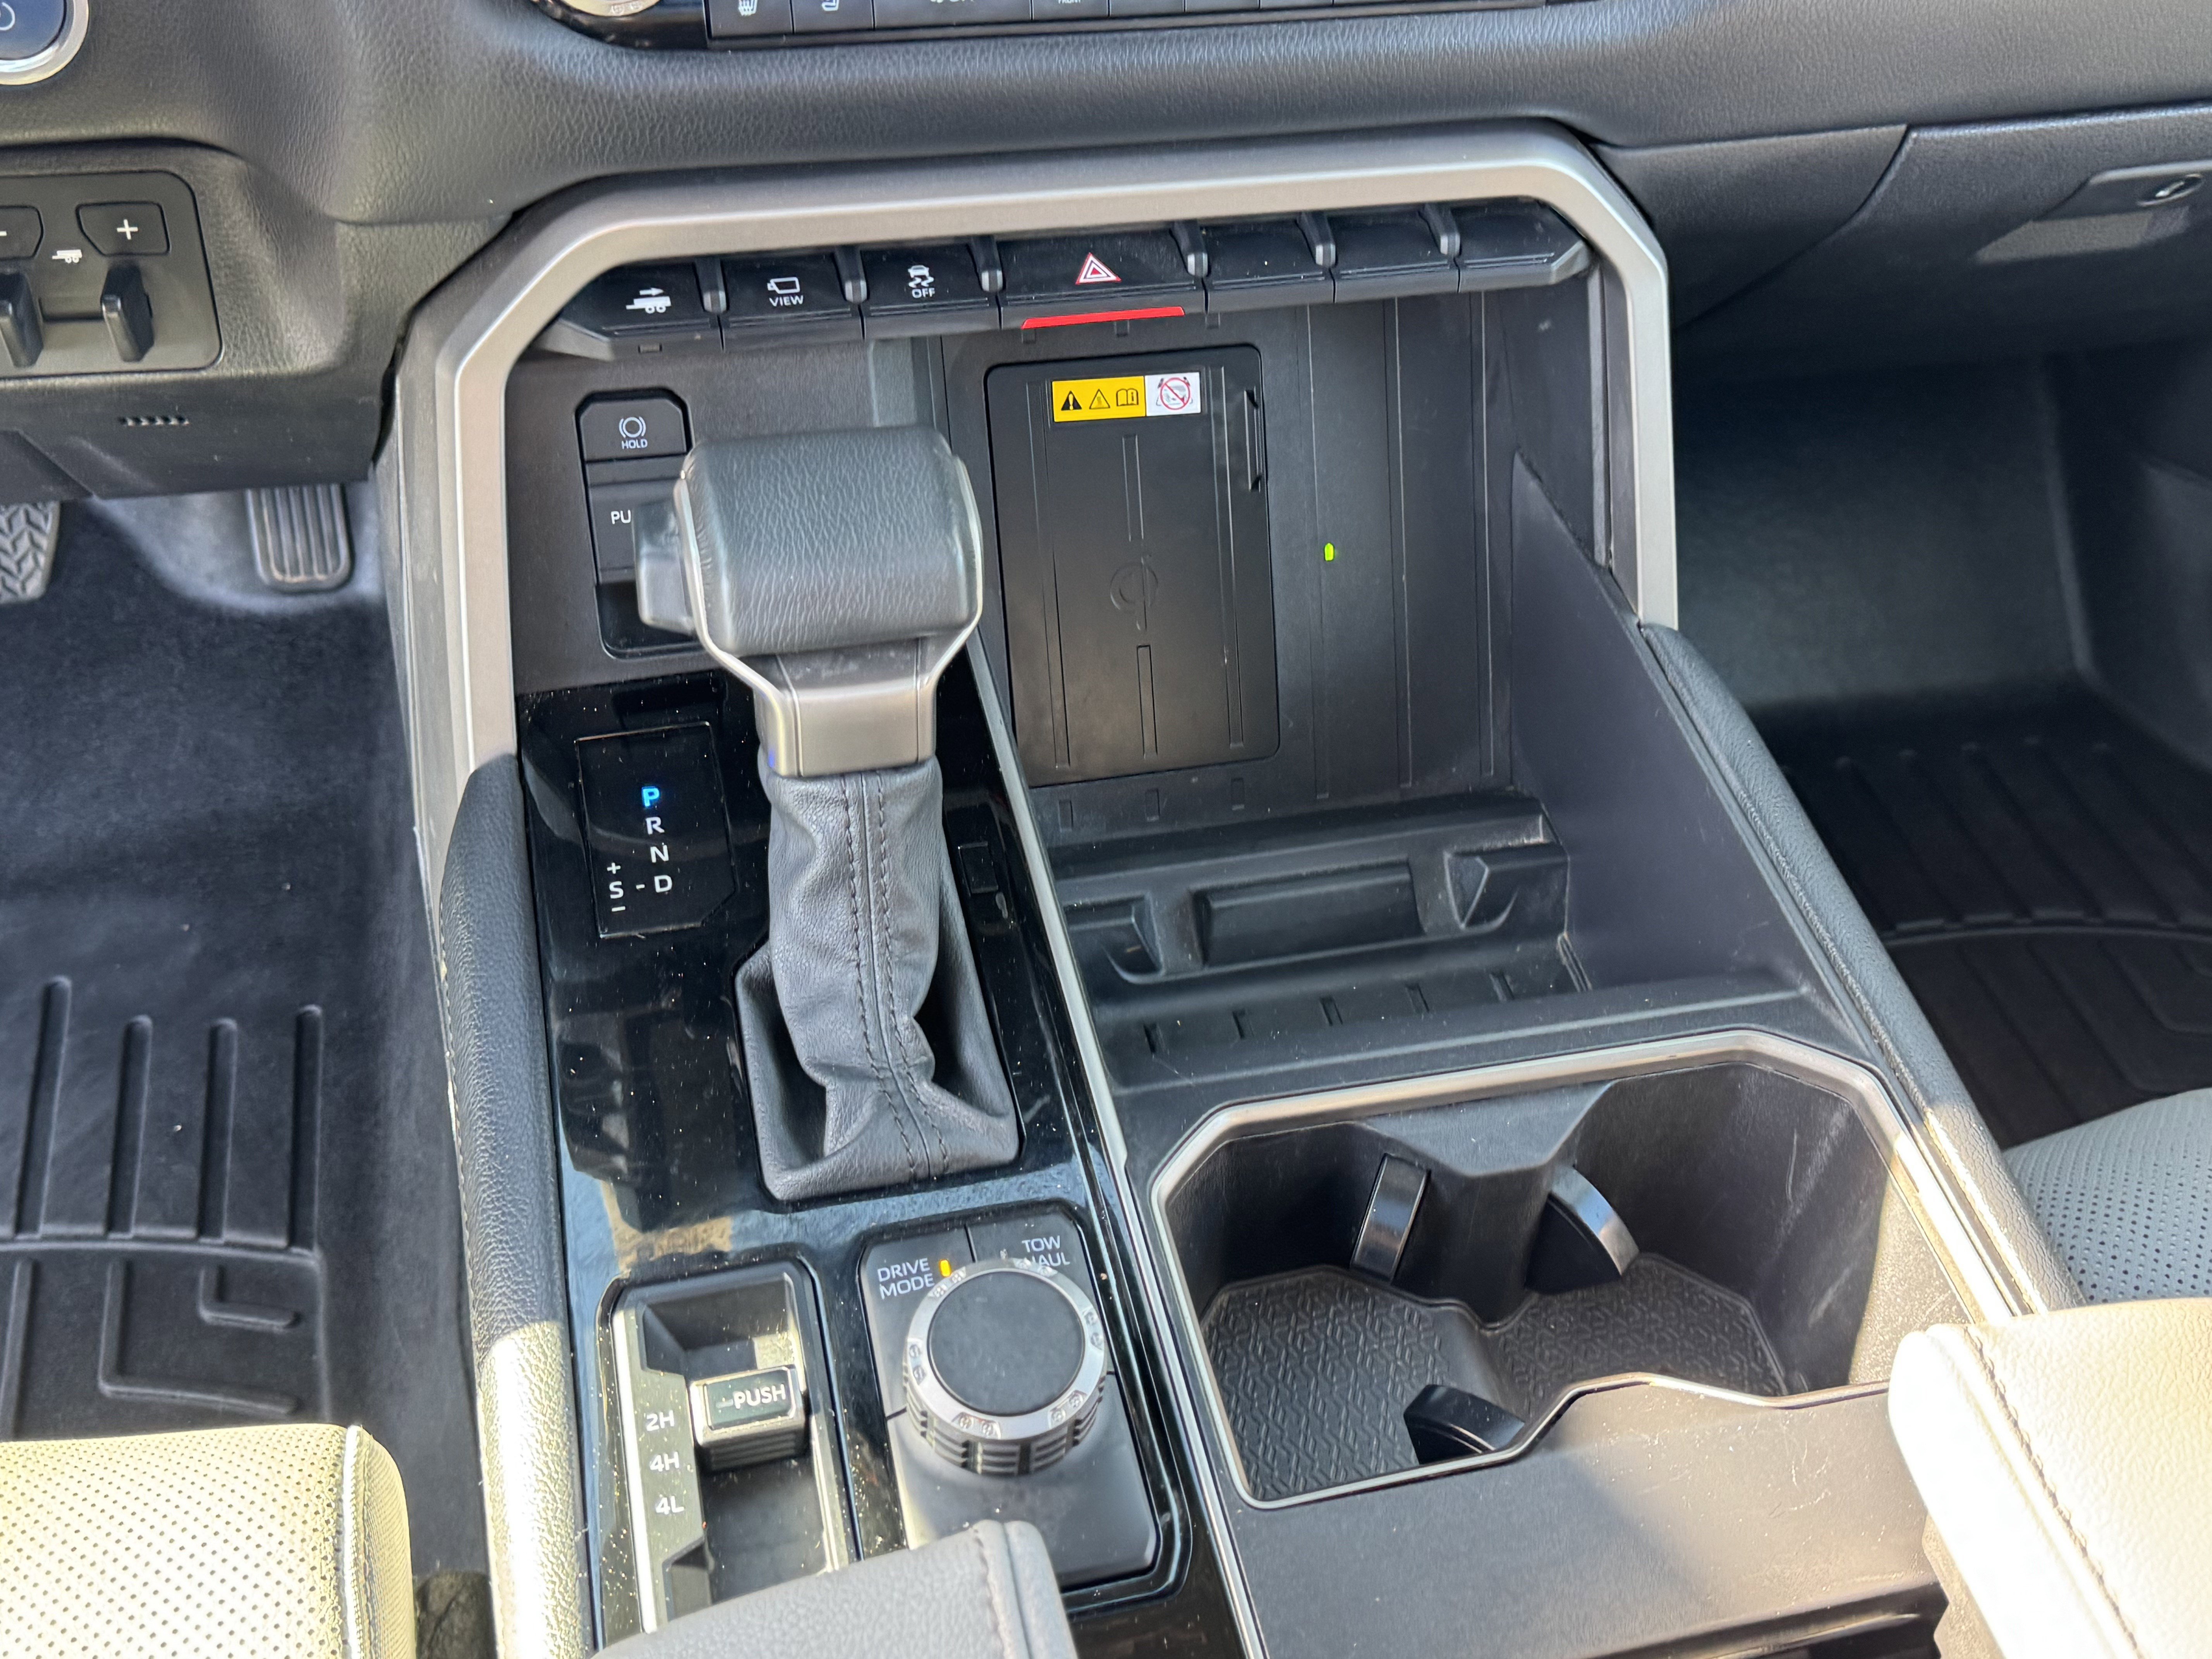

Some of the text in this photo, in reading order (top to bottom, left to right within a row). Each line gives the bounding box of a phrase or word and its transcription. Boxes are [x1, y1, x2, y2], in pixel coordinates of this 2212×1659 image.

[769, 294, 803, 306] VIEW
[912, 287, 935, 298] OFF
[622, 439, 647, 449] HOLD
[611, 510, 631, 524] PU
[642, 786, 659, 806] P
[646, 817, 664, 834] R
[651, 845, 669, 862] N
[609, 875, 672, 898] S D
[1022, 1235, 1060, 1252] TOW
[877, 1257, 930, 1282] DRIVE
[879, 1273, 934, 1299] MODE
[646, 1410, 674, 1431] 2H
[650, 1451, 679, 1472] 4H
[656, 1496, 684, 1515] 4L
